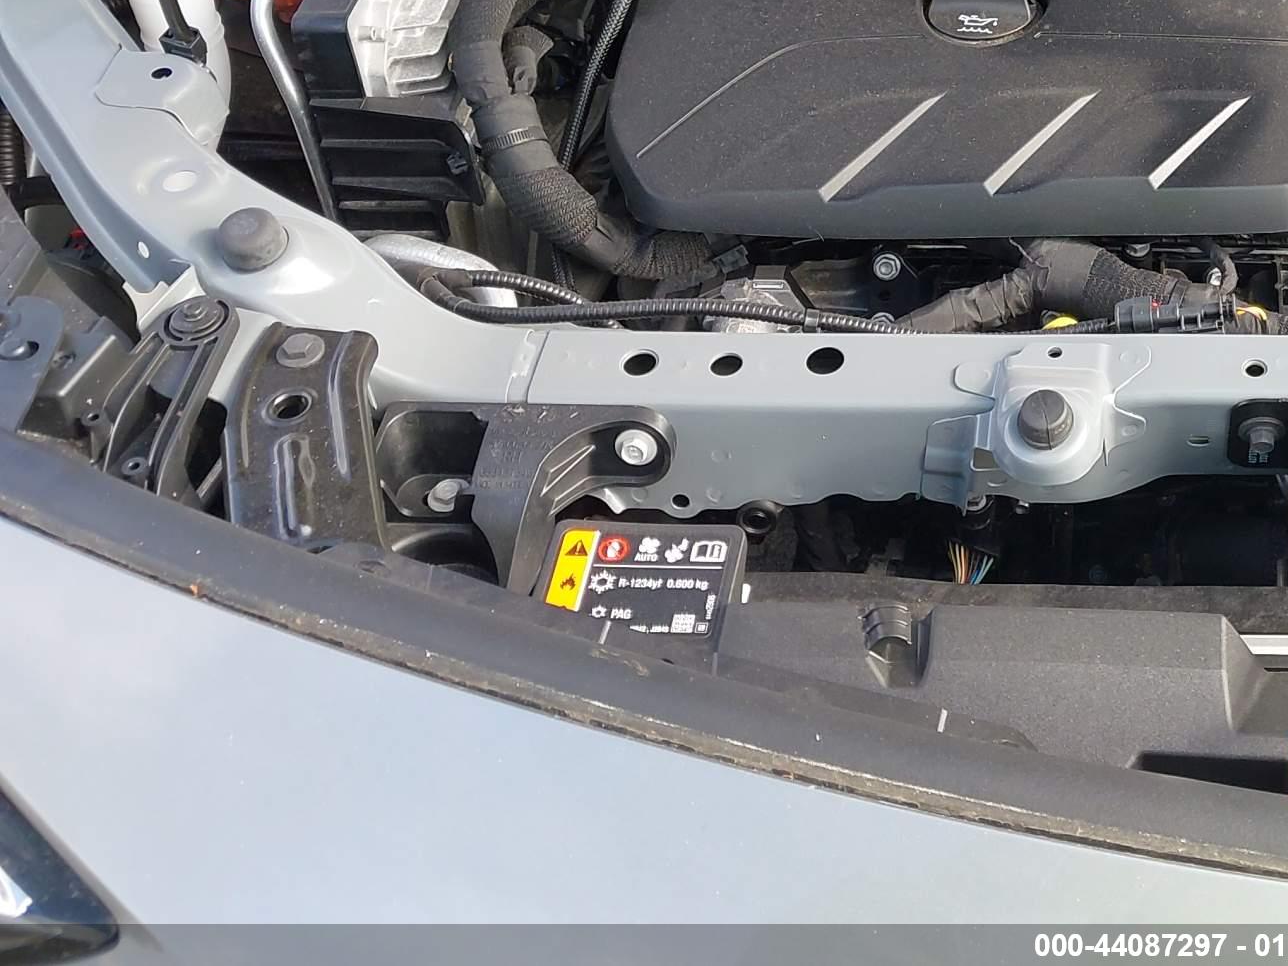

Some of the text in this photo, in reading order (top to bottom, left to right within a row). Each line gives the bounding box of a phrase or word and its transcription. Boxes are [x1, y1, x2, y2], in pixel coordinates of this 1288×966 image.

[634, 553, 659, 562] AUTO
[695, 580, 709, 591] kg
[611, 609, 632, 620] PAG
